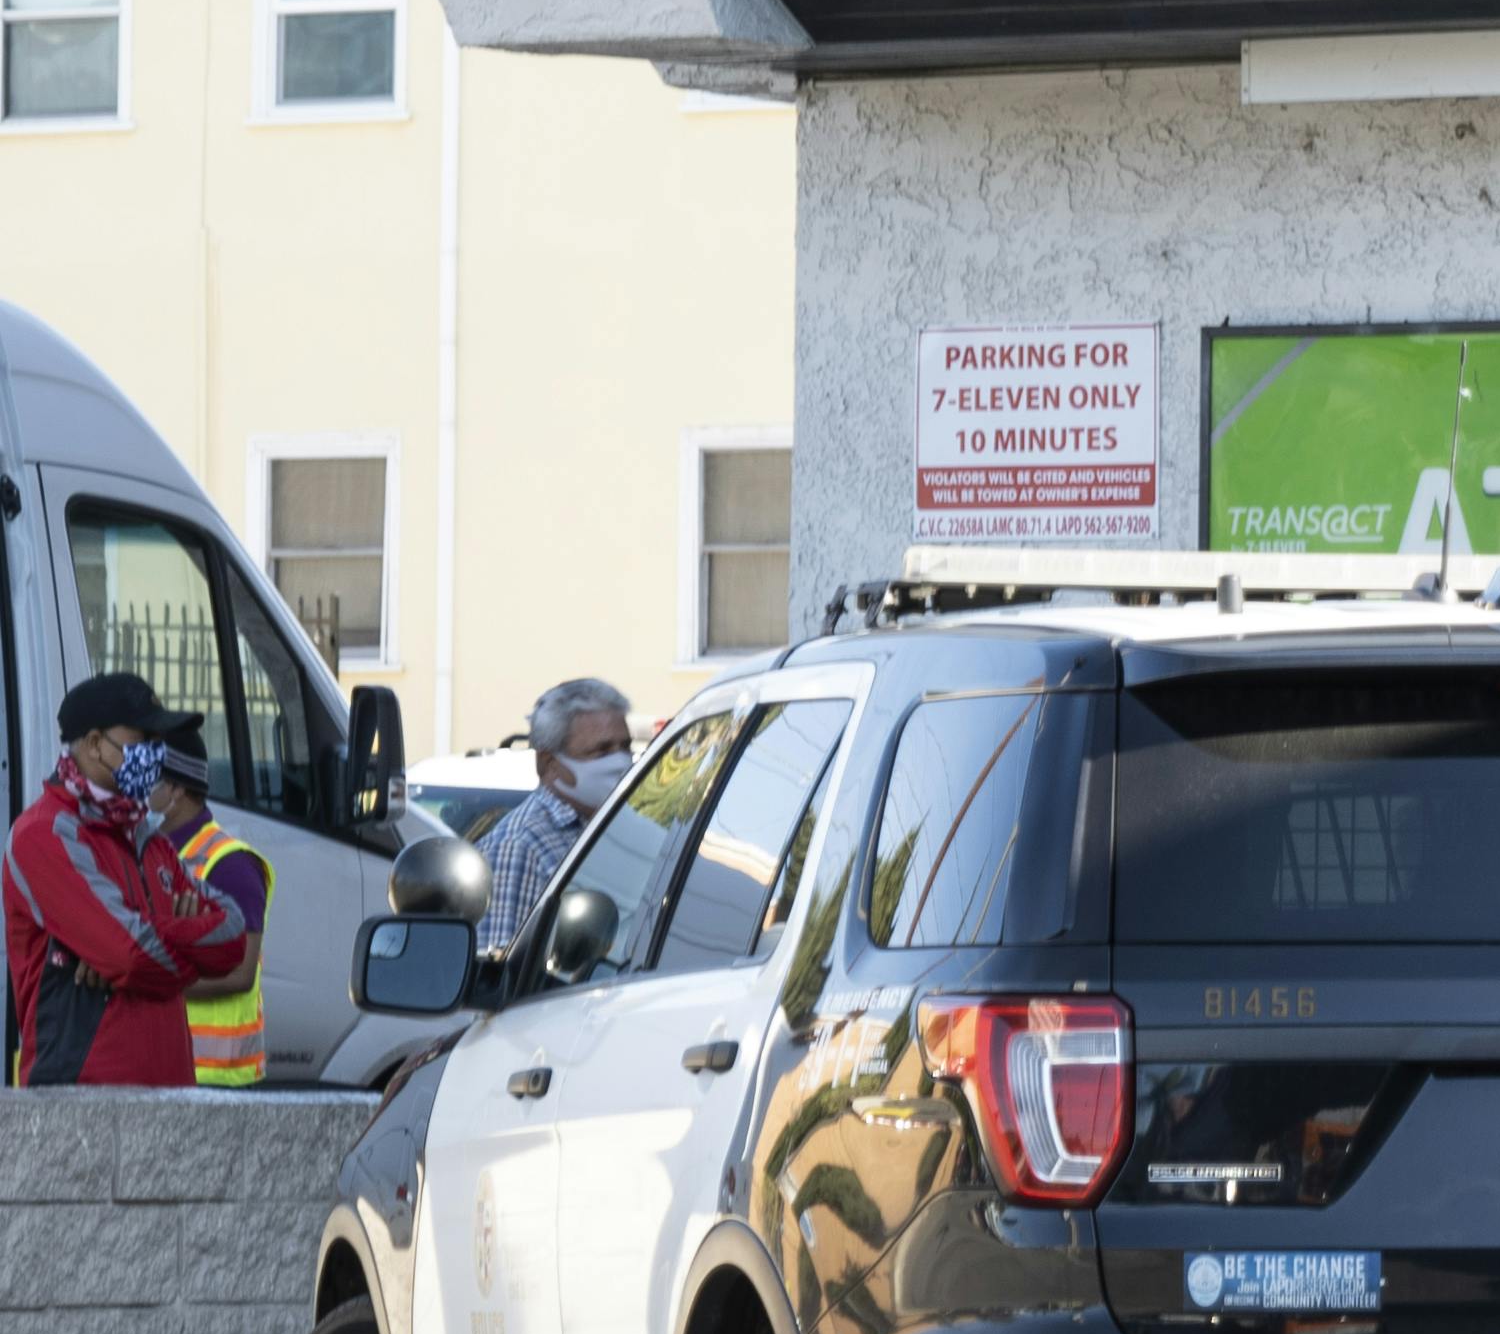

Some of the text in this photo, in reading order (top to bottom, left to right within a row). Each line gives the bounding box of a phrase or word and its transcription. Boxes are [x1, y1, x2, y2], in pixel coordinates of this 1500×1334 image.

[945, 342, 1128, 371] PARKING FOR
[932, 383, 1141, 413] 7-ELEVEN ONLY
[956, 426, 1118, 454] 10 MINUTES
[923, 468, 1150, 486] VIOLATORS WILL BE CITED AND VEHICLES
[932, 486, 1140, 503] WILL BE TOWED AT OWNER'S EXPENSE
[919, 520, 946, 537] C.V.C.
[948, 520, 984, 536] 22658A
[986, 519, 1014, 536] LAMC
[1055, 517, 1082, 534] LAPD
[1084, 516, 1151, 534] 562-567-9200
[1227, 504, 1392, 544] TRANS@CT
[1204, 987, 1316, 1018] 81456
[1152, 1168, 1277, 1179] POLICE INTERCEPTOR
[1224, 1255, 1365, 1279] BE THE CHANGE
[1237, 1280, 1260, 1294] Join
[1263, 1293, 1377, 1308] COMMUNITY VOLUNTEER
